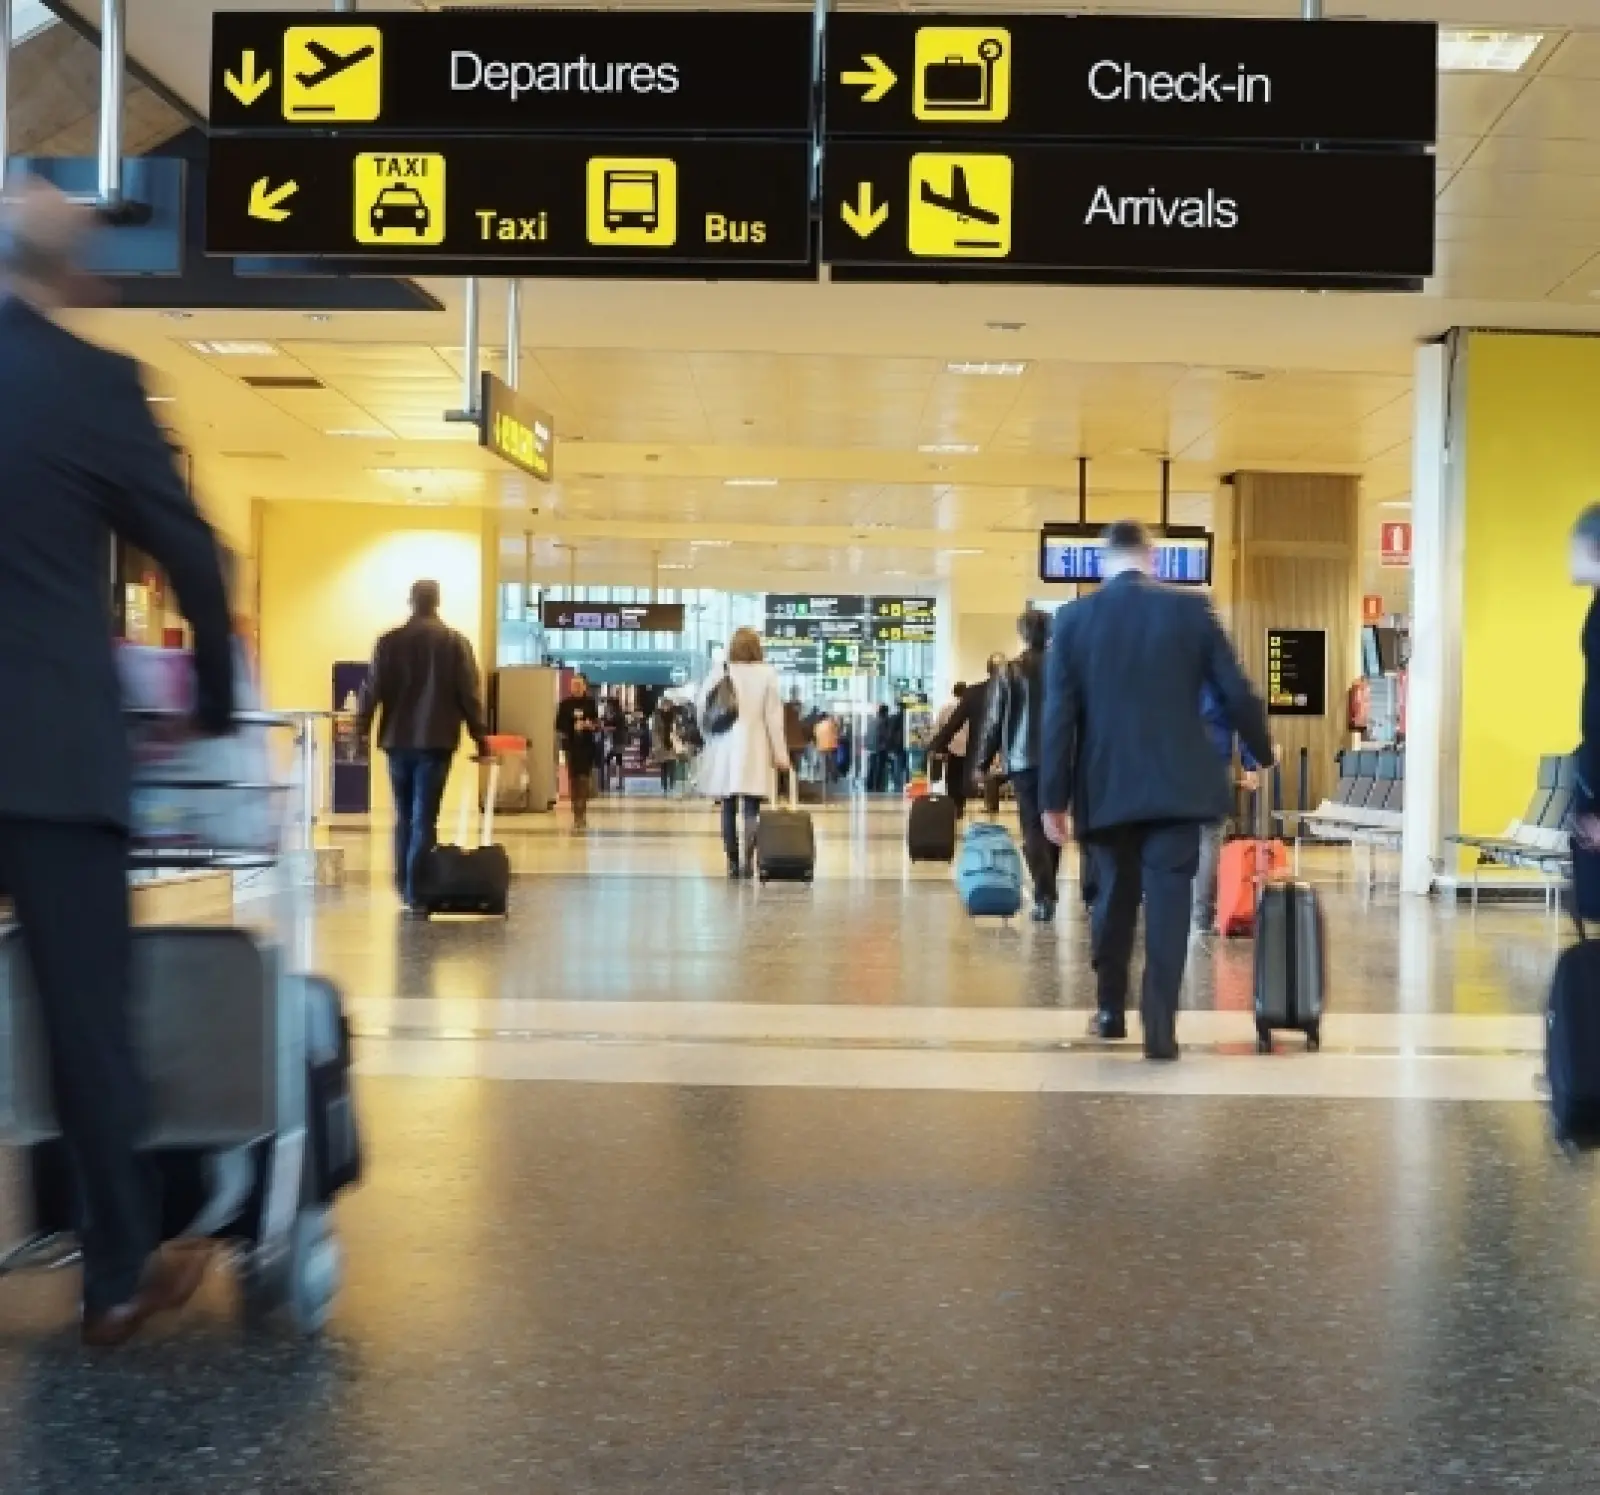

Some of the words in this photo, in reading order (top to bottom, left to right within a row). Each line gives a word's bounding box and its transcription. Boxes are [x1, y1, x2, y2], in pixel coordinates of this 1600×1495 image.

[450, 51, 679, 101] Departures
[1087, 60, 1271, 103] Check-in
[373, 157, 428, 177] TAXI
[475, 211, 548, 241] Taxi
[705, 215, 767, 243] Bus
[1084, 186, 1238, 228] Arrivals
